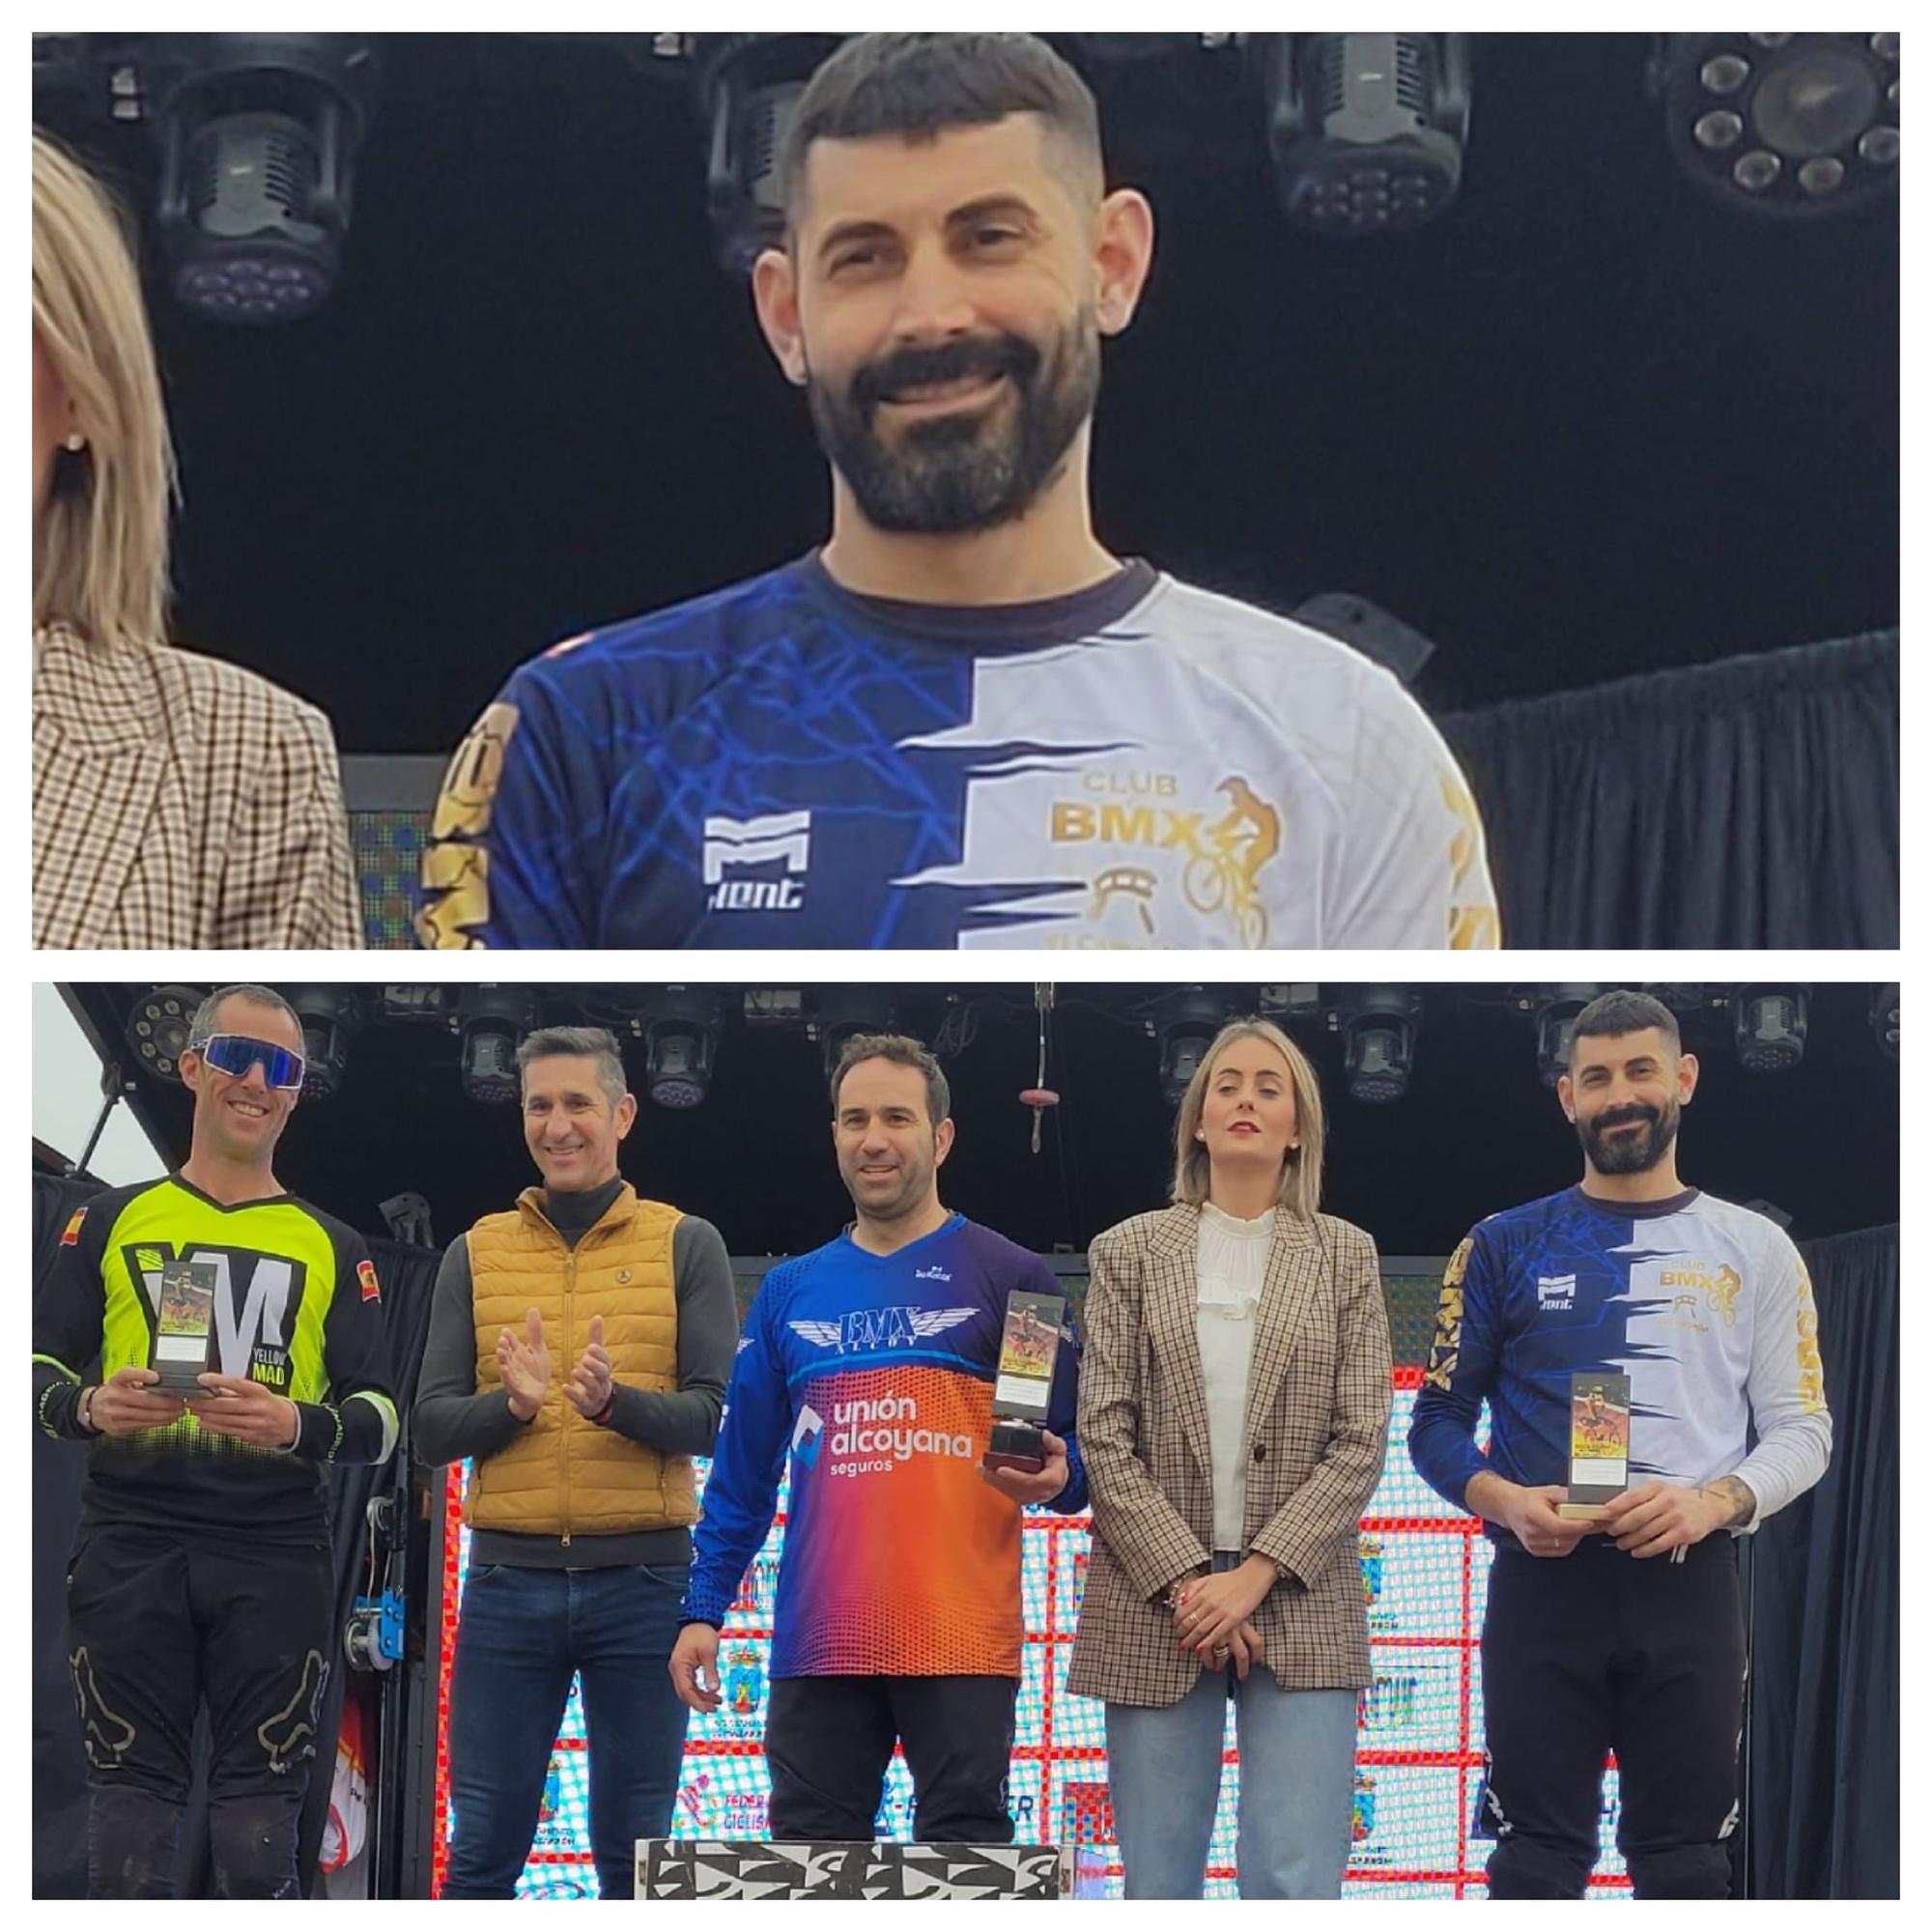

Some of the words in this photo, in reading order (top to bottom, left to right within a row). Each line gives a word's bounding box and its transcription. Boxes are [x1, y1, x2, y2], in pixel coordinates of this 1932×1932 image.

[1083, 770, 1177, 795] CLUB
[1052, 802, 1204, 858] BMX
[1660, 1271, 1716, 1293] BMX
[838, 1306, 921, 1346] BMX
[253, 1347, 287, 1366] YELLOW
[252, 1362, 285, 1385] MAD
[834, 1390, 917, 1424] unión
[831, 1422, 972, 1461] alcoyana
[830, 1459, 894, 1478] seguros
